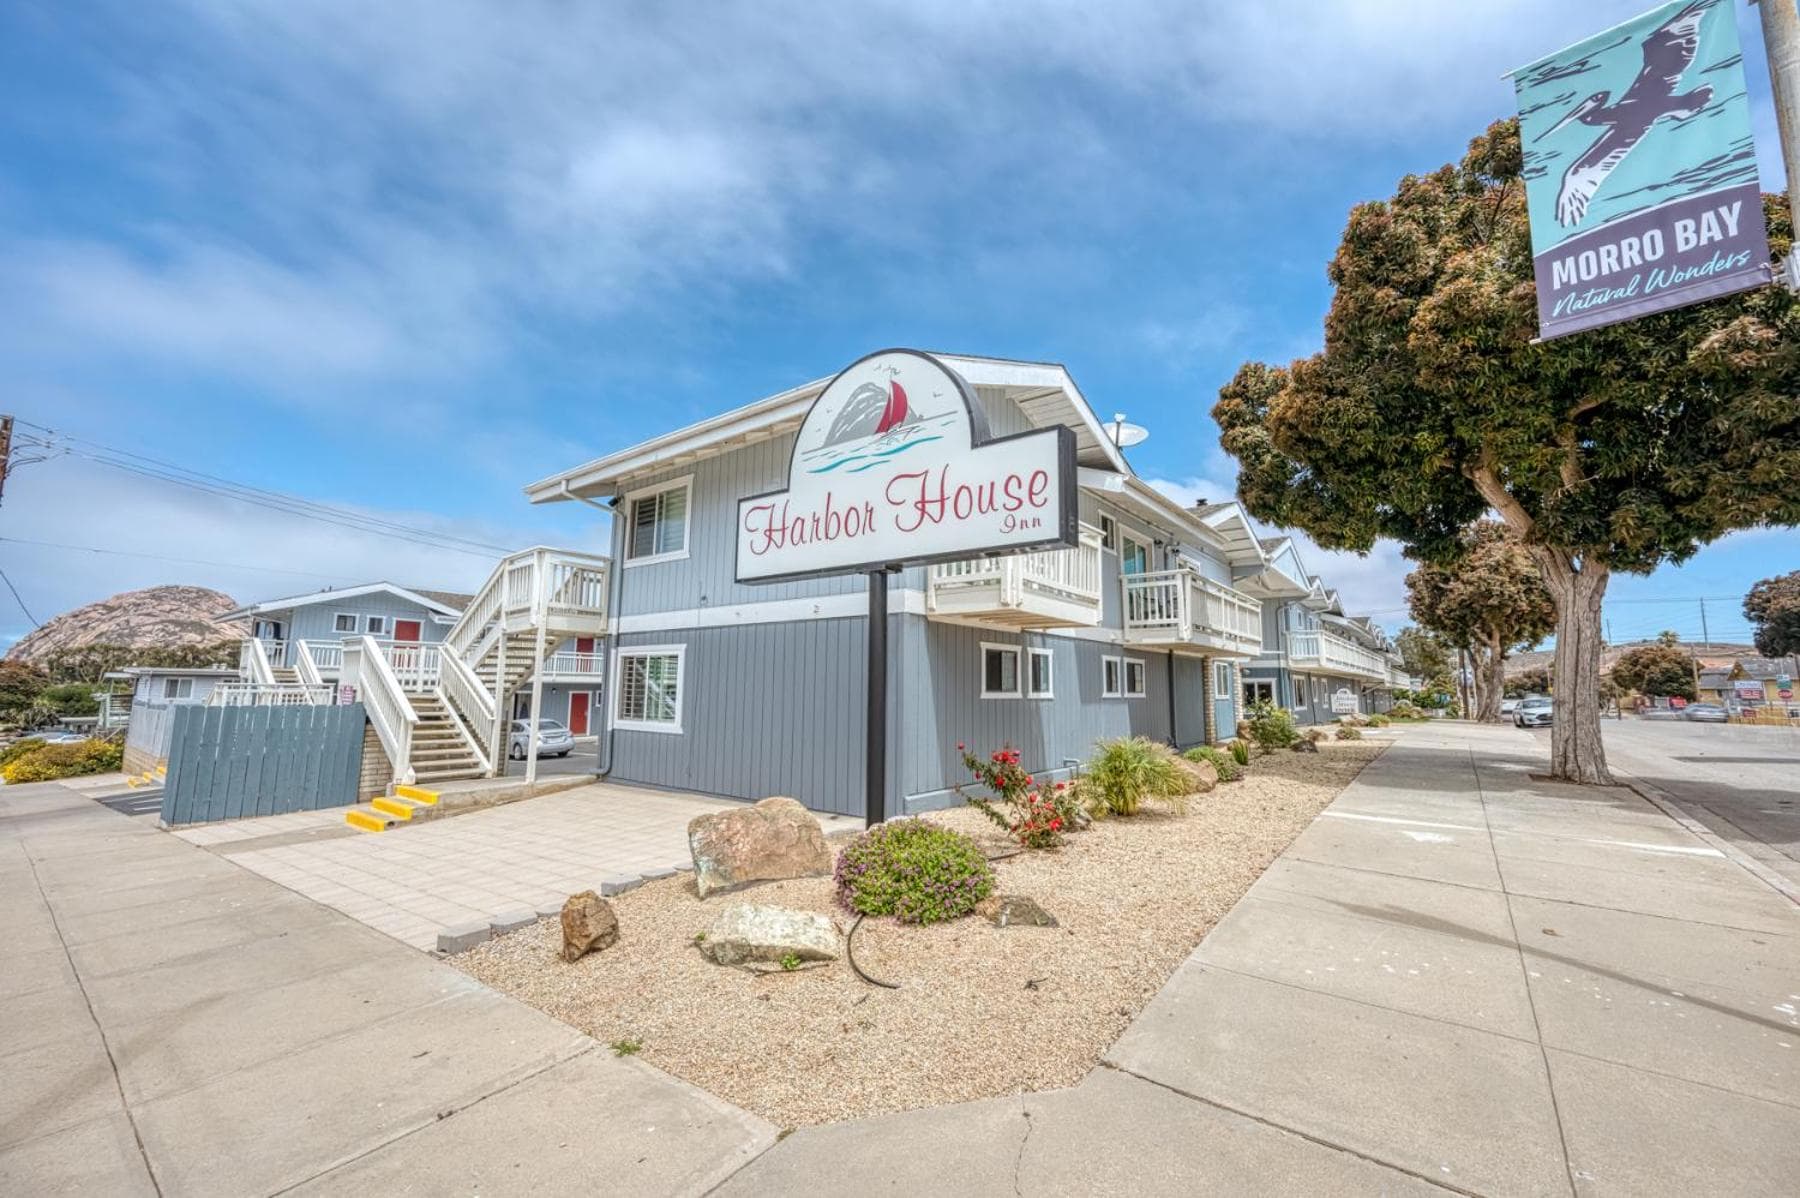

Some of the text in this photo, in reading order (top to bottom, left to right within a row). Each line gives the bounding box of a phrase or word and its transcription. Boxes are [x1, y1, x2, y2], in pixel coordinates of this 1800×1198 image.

[1551, 249, 1751, 318] Natural Wonders
[1552, 200, 1742, 291] MORRO BAY
[744, 463, 1050, 556] Harbor House
[1000, 514, 1042, 534] Inn
